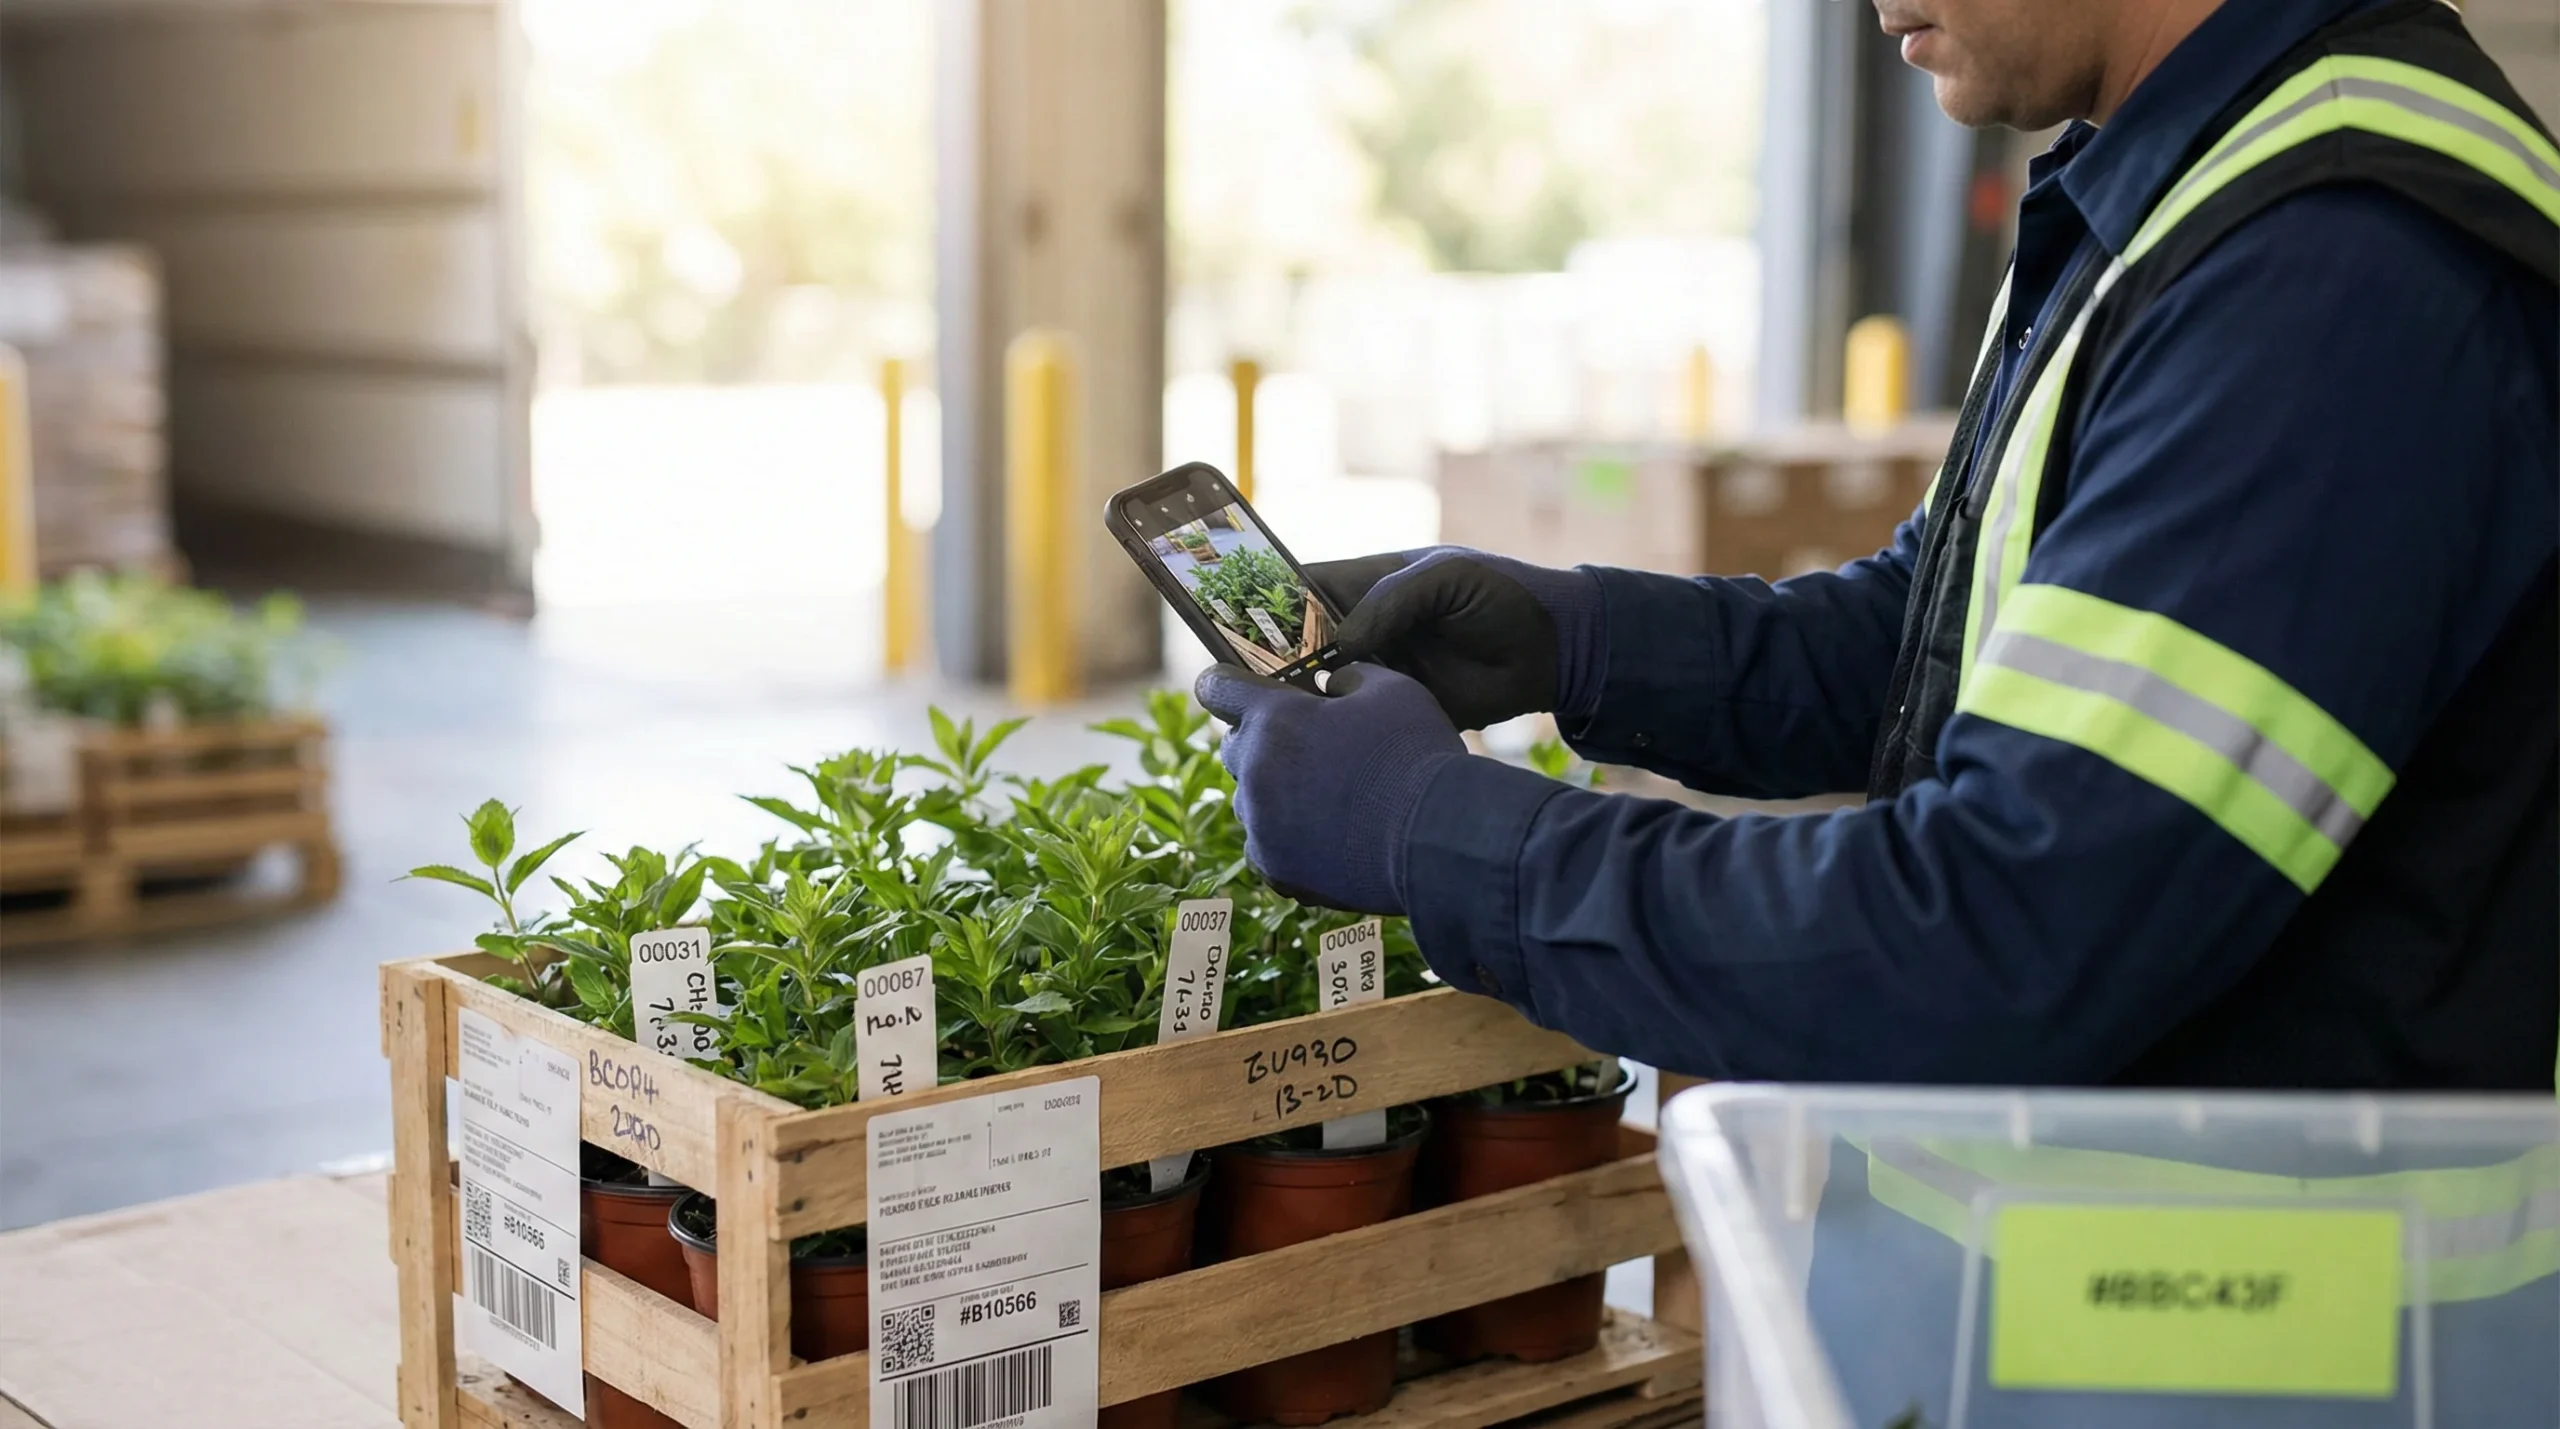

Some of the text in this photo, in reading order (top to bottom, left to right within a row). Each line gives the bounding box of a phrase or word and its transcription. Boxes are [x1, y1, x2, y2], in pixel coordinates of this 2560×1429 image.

[1181, 911, 1227, 931] 00037
[1326, 923, 1375, 950] 00084
[639, 940, 701, 963] 00031
[960, 1291, 1036, 1325] #B10566
